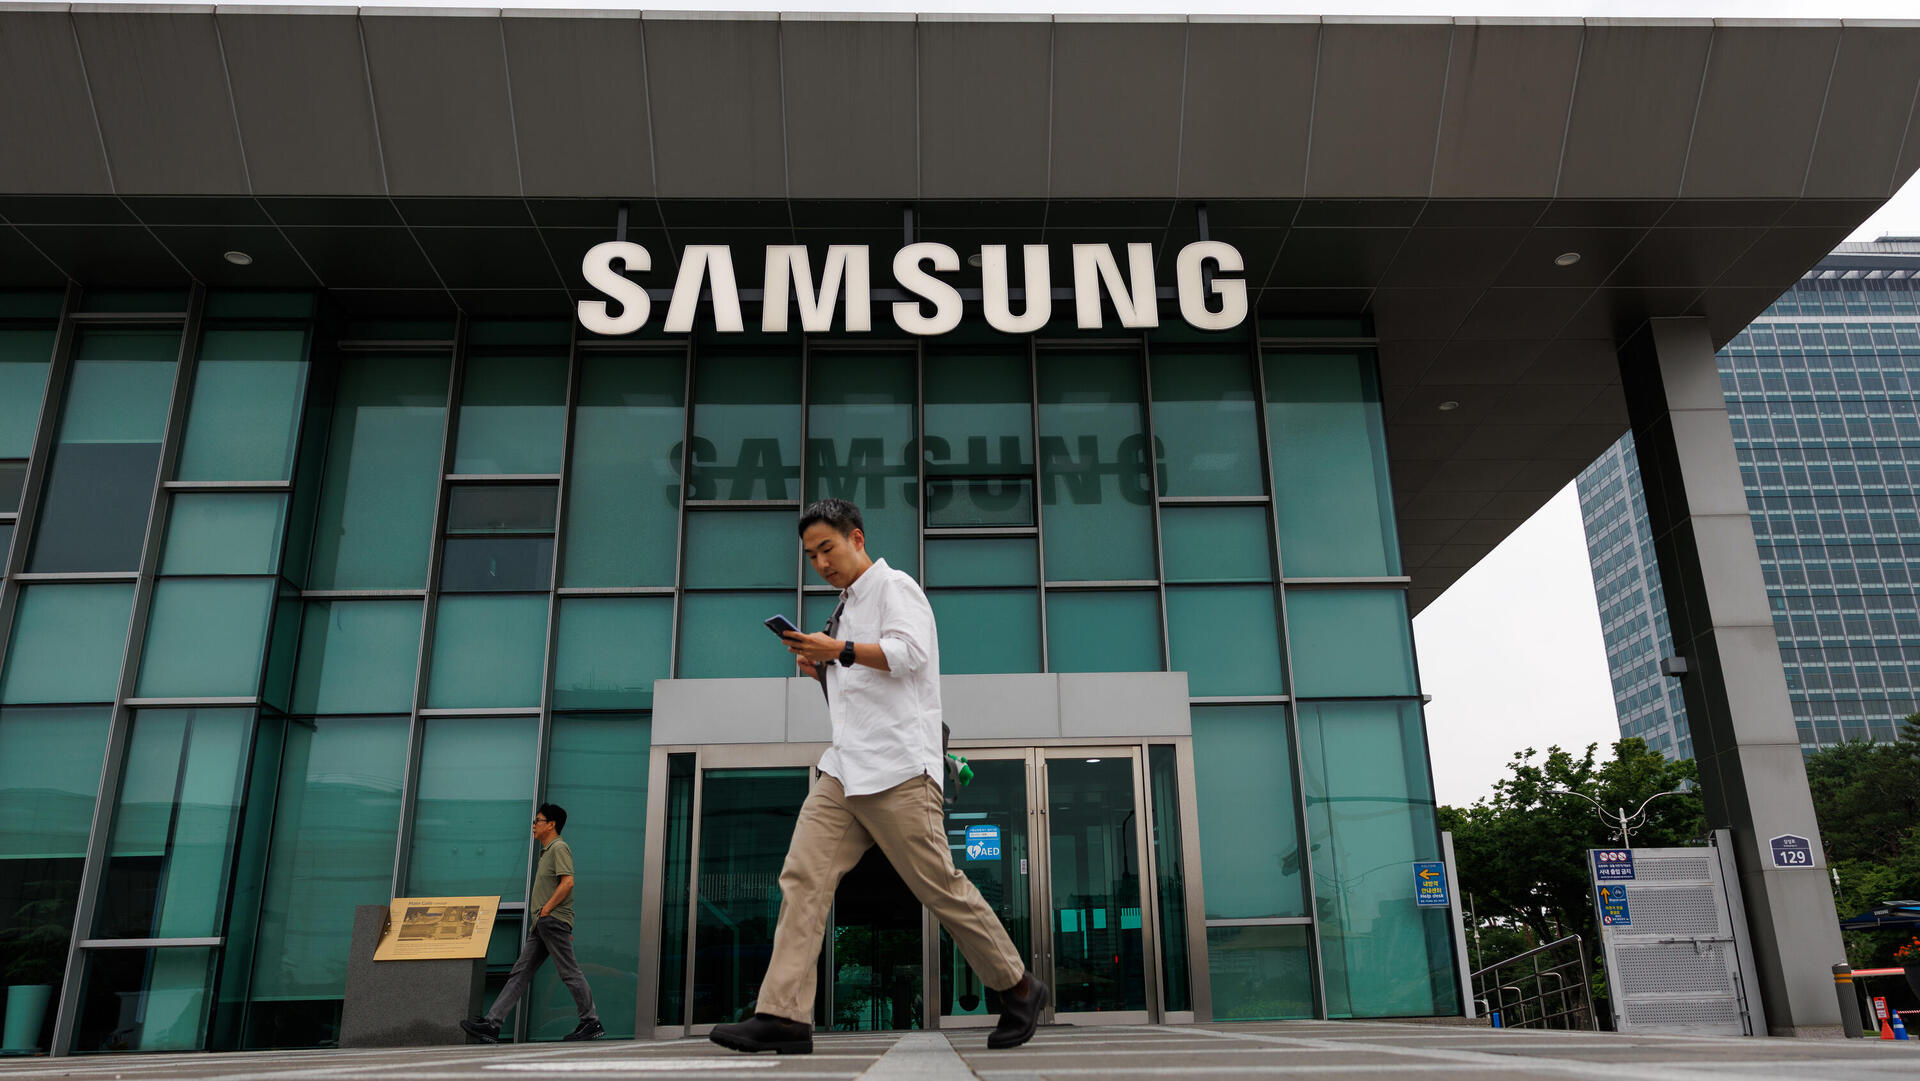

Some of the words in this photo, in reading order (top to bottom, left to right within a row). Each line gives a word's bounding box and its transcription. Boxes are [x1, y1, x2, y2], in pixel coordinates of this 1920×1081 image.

[577, 241, 1248, 335] SAMSUNG
[665, 433, 1170, 512] SAMSUNG
[980, 847, 1000, 856] AED
[1780, 850, 1806, 864] 129
